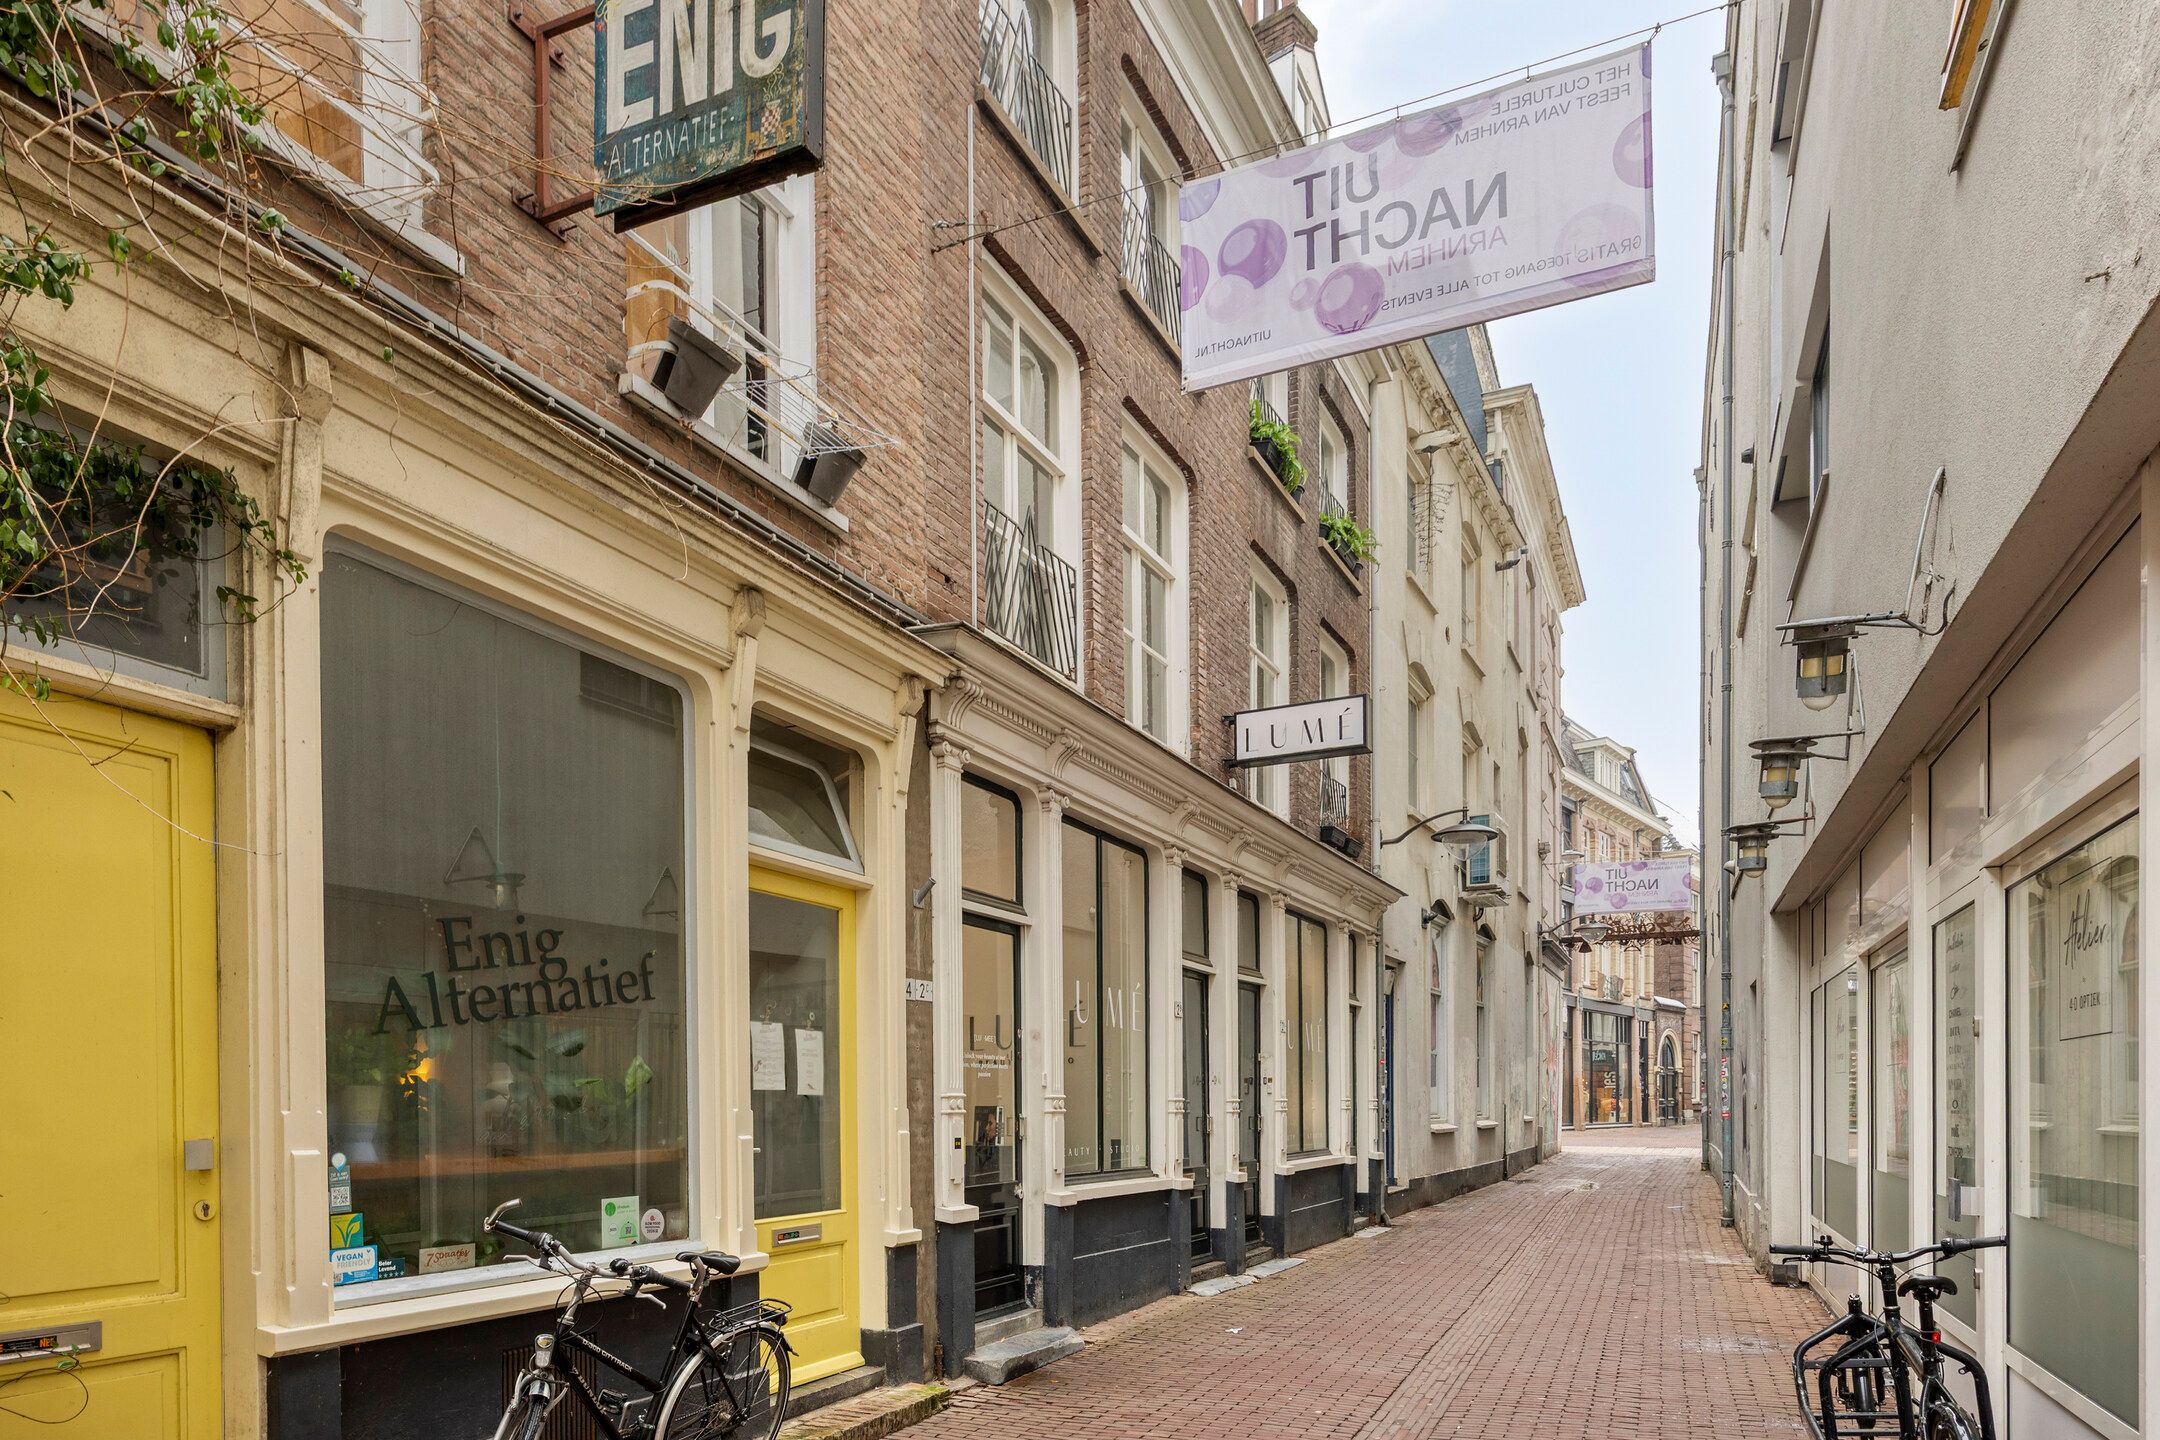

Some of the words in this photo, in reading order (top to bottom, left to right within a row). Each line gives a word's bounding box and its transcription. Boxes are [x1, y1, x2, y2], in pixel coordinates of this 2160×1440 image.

[606, 0, 792, 135] ENIG
[607, 107, 728, 178] ALTERNATIEF
[1245, 707, 1355, 752] LUMÉ
[436, 914, 568, 983] Enig
[2064, 888, 2107, 970] Atelier
[371, 950, 657, 1036] Alternatief
[1064, 979, 1142, 1032] UMÉ
[1064, 1146, 1091, 1158] AUTY
[336, 1252, 364, 1262] VEGAN
[336, 1259, 370, 1269] FRIENDLY
